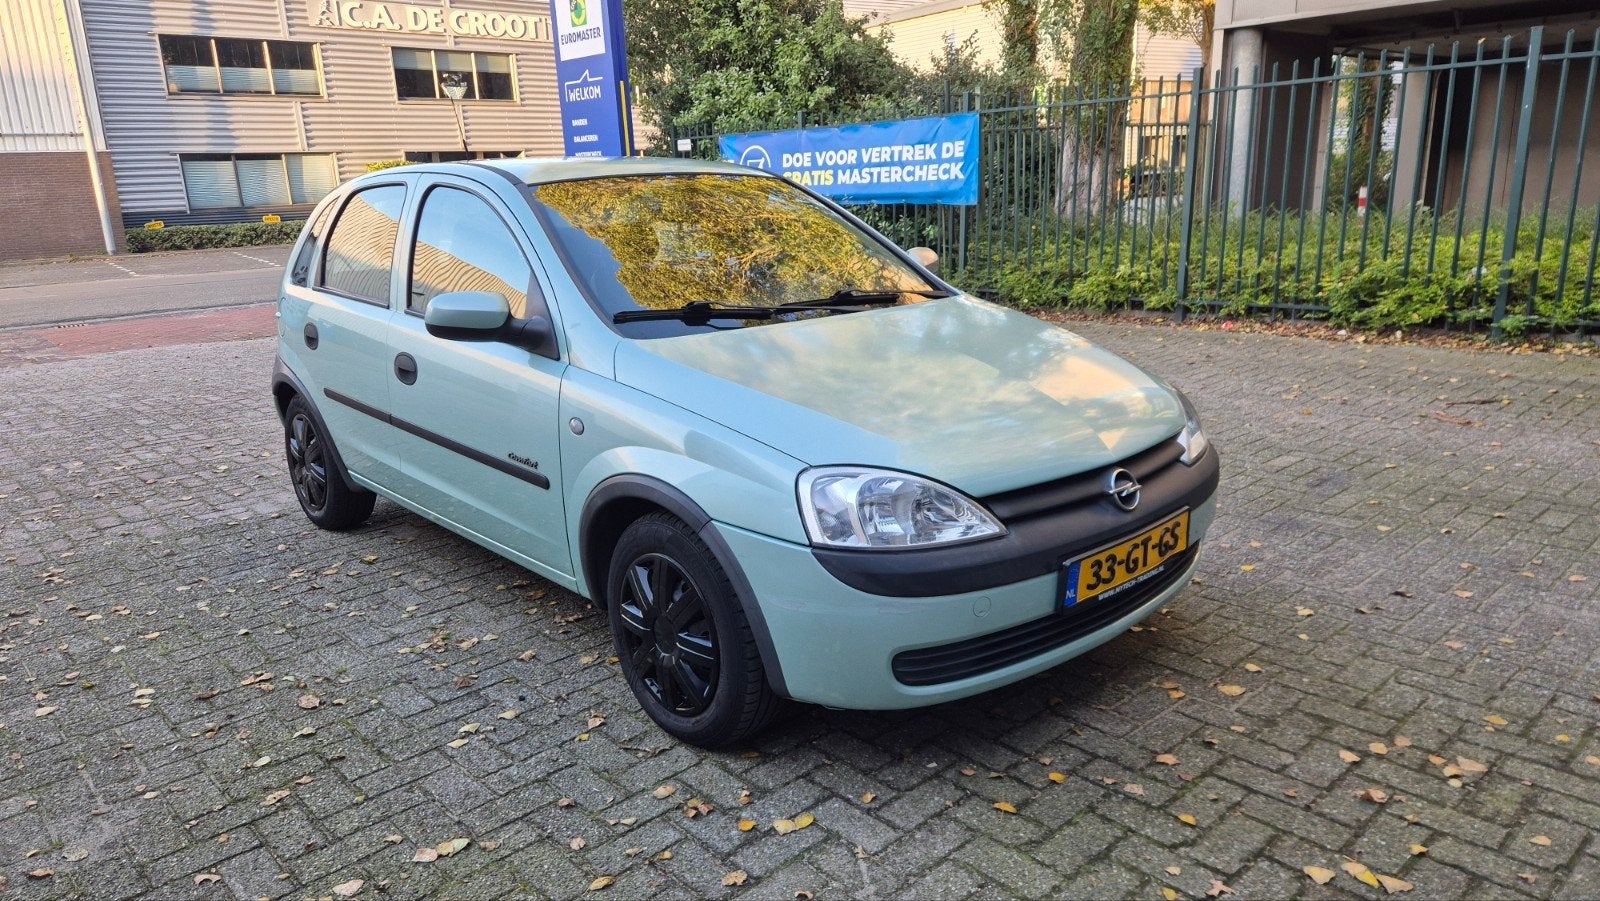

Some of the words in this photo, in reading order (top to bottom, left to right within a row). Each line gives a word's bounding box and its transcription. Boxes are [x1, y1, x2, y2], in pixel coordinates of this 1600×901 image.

[341, 1, 401, 30] C.A.
[406, 7, 445, 33] DE
[449, 10, 541, 39] GROOT
[561, 27, 601, 45] EUROMASTER
[569, 85, 601, 102] WELKOM
[782, 152, 811, 168] DOE
[815, 148, 858, 167] VOOR
[861, 143, 938, 164] VERTREK
[941, 140, 965, 159] DE
[837, 162, 965, 185] MASTERCHECK
[1086, 521, 1181, 591] 33-GT-GS
[1065, 589, 1076, 600] NL
